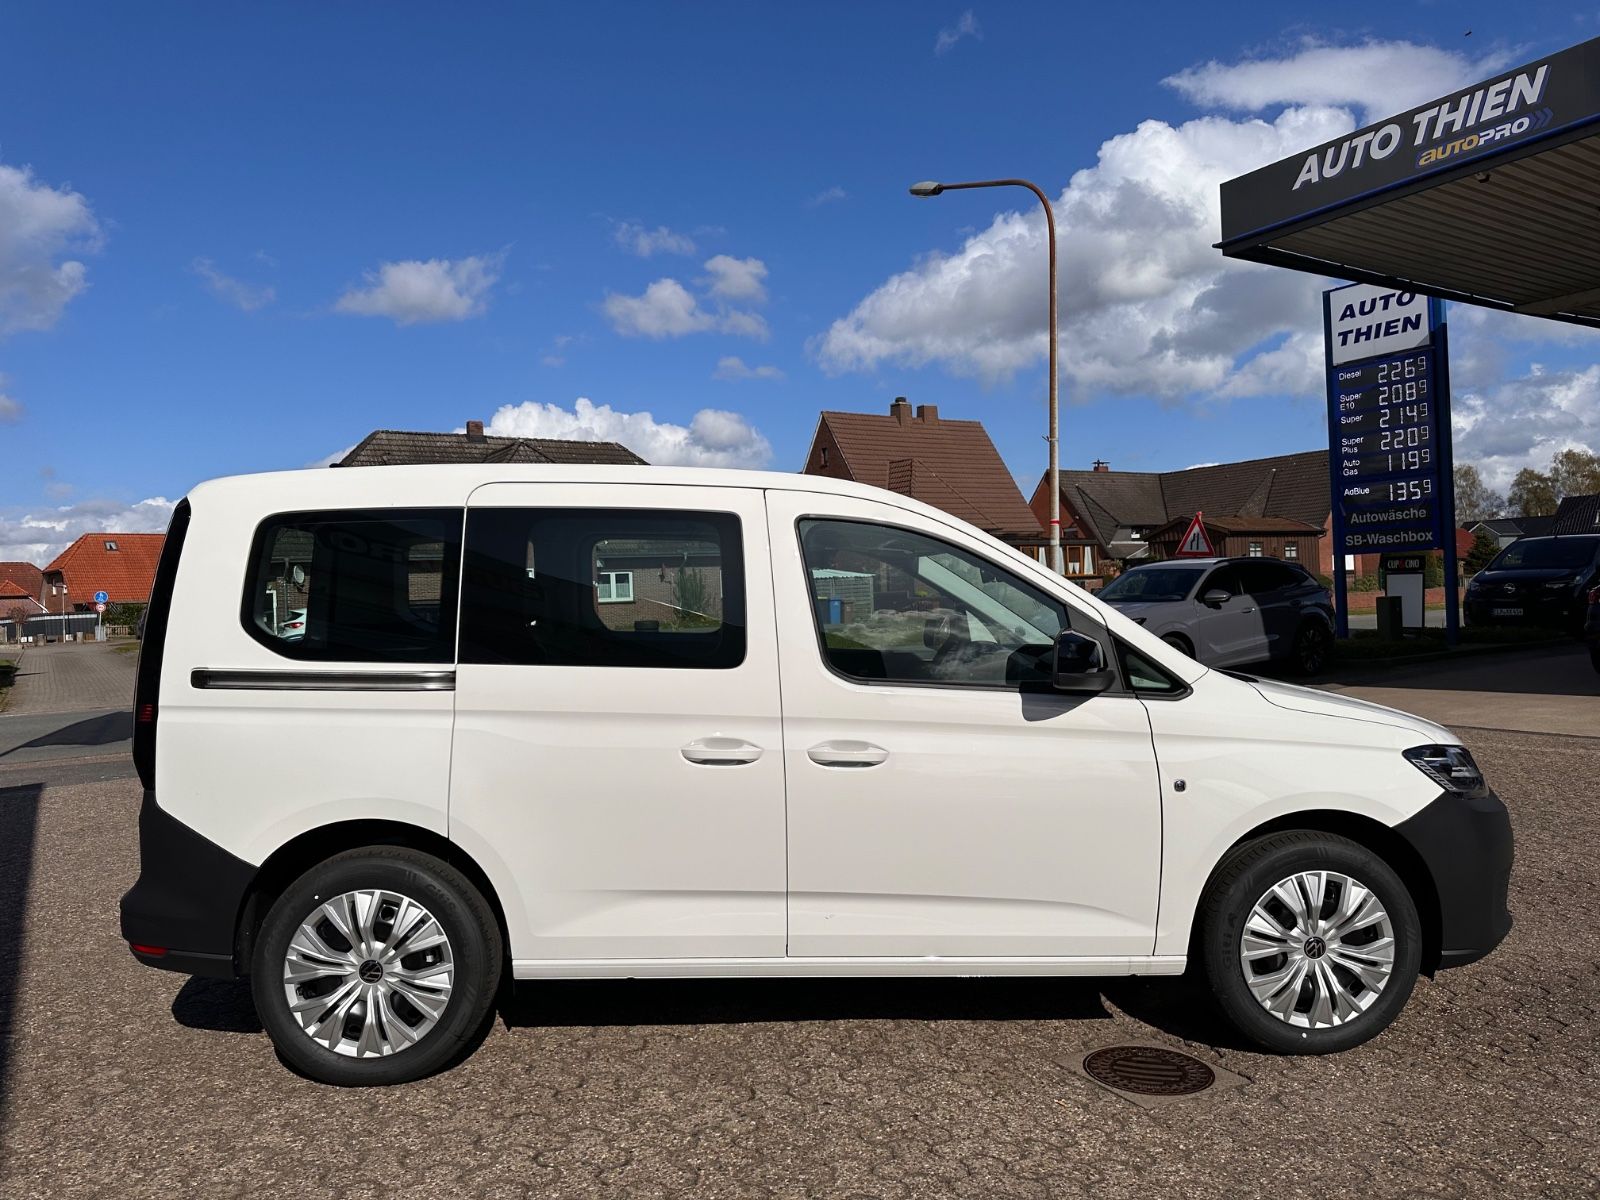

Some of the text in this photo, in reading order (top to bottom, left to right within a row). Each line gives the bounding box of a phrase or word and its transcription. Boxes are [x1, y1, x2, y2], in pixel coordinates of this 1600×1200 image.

[1292, 64, 1548, 191] AUTO THIEN
[1339, 290, 1416, 322] AUTO
[1338, 313, 1422, 347] THIEN
[1338, 370, 1362, 381] Diesel
[1340, 393, 1362, 403] Super
[1340, 402, 1355, 411] E10
[1340, 415, 1364, 425] Super
[1341, 436, 1364, 446] Super
[1341, 446, 1358, 454] Plus
[1342, 459, 1360, 468] Auto
[1342, 468, 1358, 476] Gas
[1343, 486, 1370, 496] AdBlue
[1350, 508, 1427, 525] Autowäsche
[1345, 531, 1433, 547] SB-Waschbox
